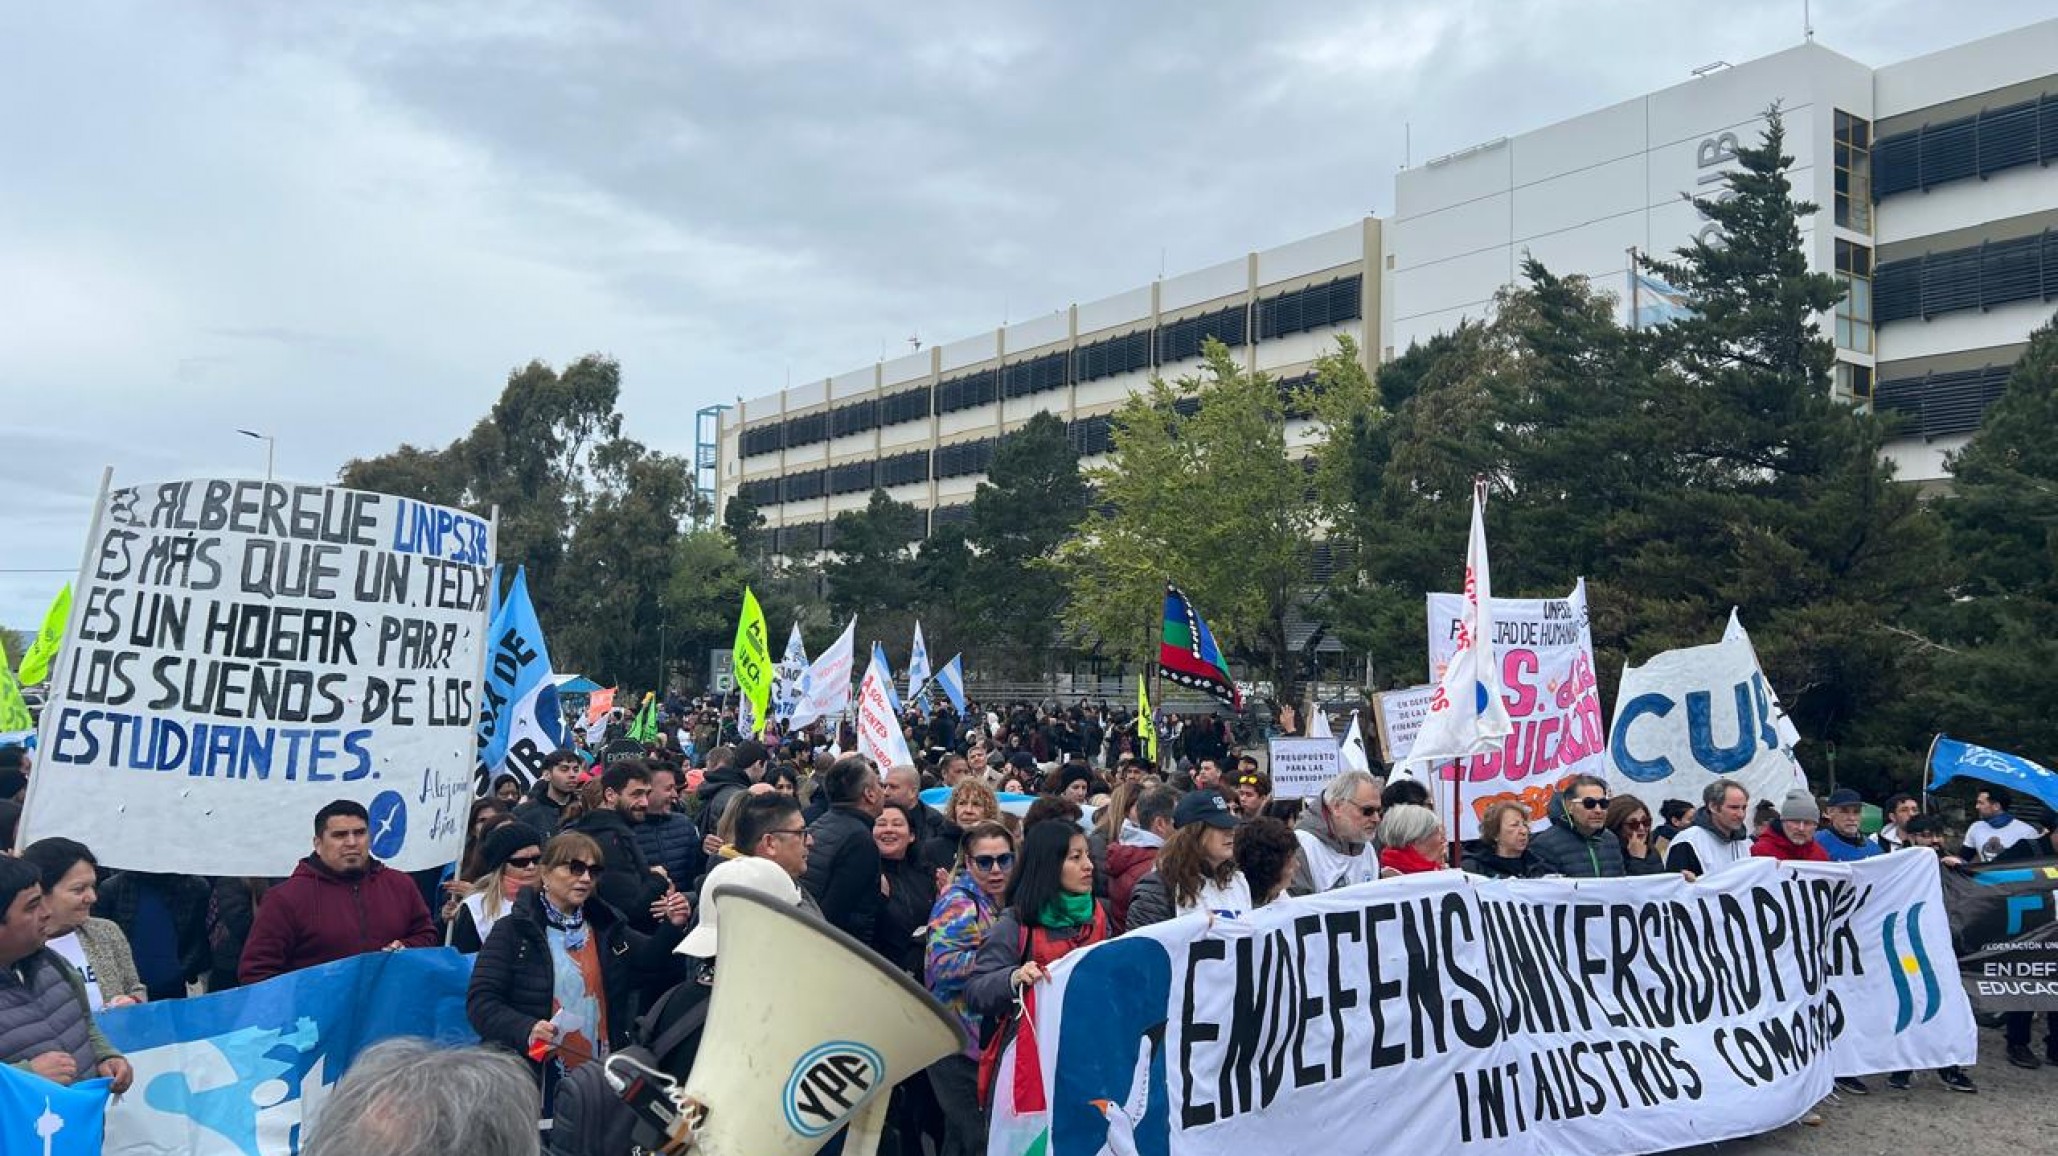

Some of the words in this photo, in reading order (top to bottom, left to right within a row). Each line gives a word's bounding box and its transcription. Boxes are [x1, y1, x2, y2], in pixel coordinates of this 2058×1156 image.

[111, 487, 147, 528] EL
[150, 480, 380, 546] ALBERGUE
[96, 528, 140, 582] ES
[138, 531, 223, 590] MÁS
[241, 539, 342, 600] QUE
[79, 586, 126, 643] ES
[129, 590, 192, 651] UN
[203, 600, 358, 666] HOGAR
[378, 615, 458, 669] PARA
[66, 646, 141, 706] LOS
[148, 655, 347, 724] SUEÑOS
[361, 675, 416, 726] DE
[428, 675, 472, 727] LOS
[51, 707, 381, 781] ESTUDIANTES.
[1275, 753, 1335, 761] PRESUPUESTO
[1309, 764, 1323, 772] LAS
[1984, 962, 2012, 977] EN
[2016, 962, 2057, 977] DEF
[797, 1055, 869, 1121] YPF
